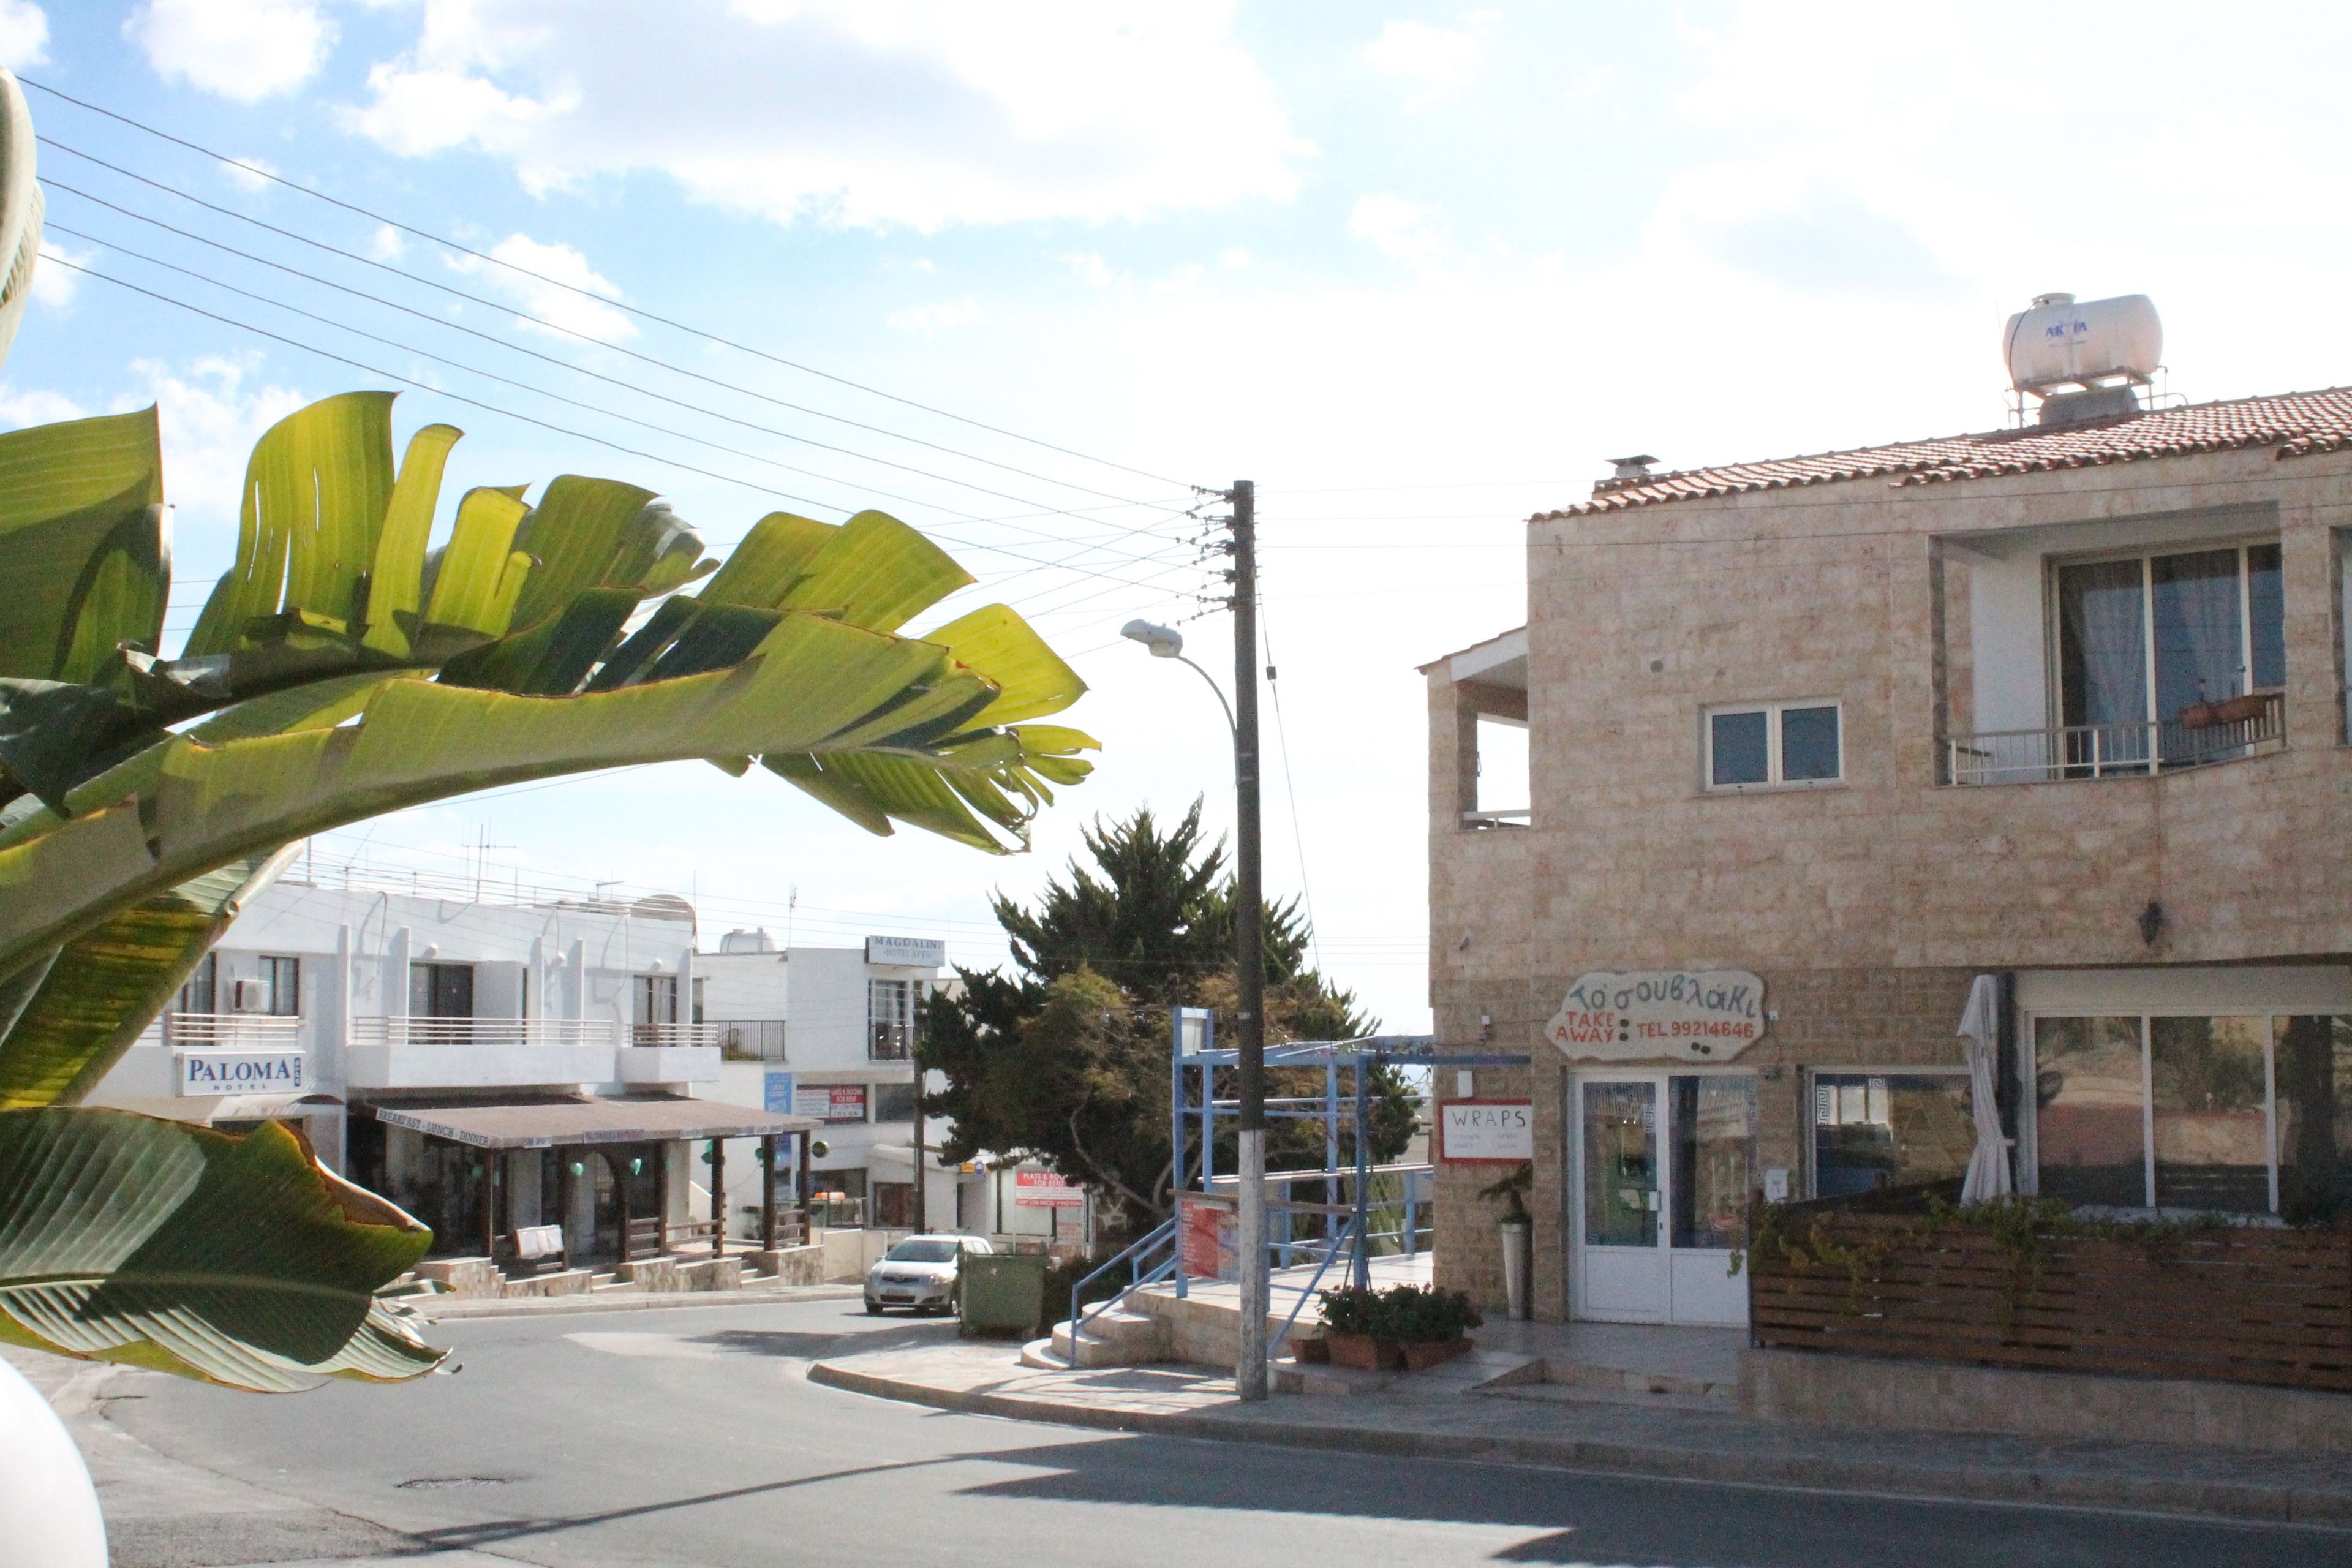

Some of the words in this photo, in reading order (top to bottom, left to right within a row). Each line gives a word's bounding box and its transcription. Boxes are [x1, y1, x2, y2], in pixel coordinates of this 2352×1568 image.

[1566, 1011, 1615, 1028] TAKE
[1556, 1025, 1614, 1043] AWAY
[1637, 1022, 1667, 1038] TEL
[189, 1058, 291, 1082] PALOMA
[379, 1109, 421, 1129] BREAKFAST
[426, 1122, 454, 1138] LUNCH
[459, 1131, 489, 1146] DINNER
[1452, 1110, 1526, 1128] WRAPS
